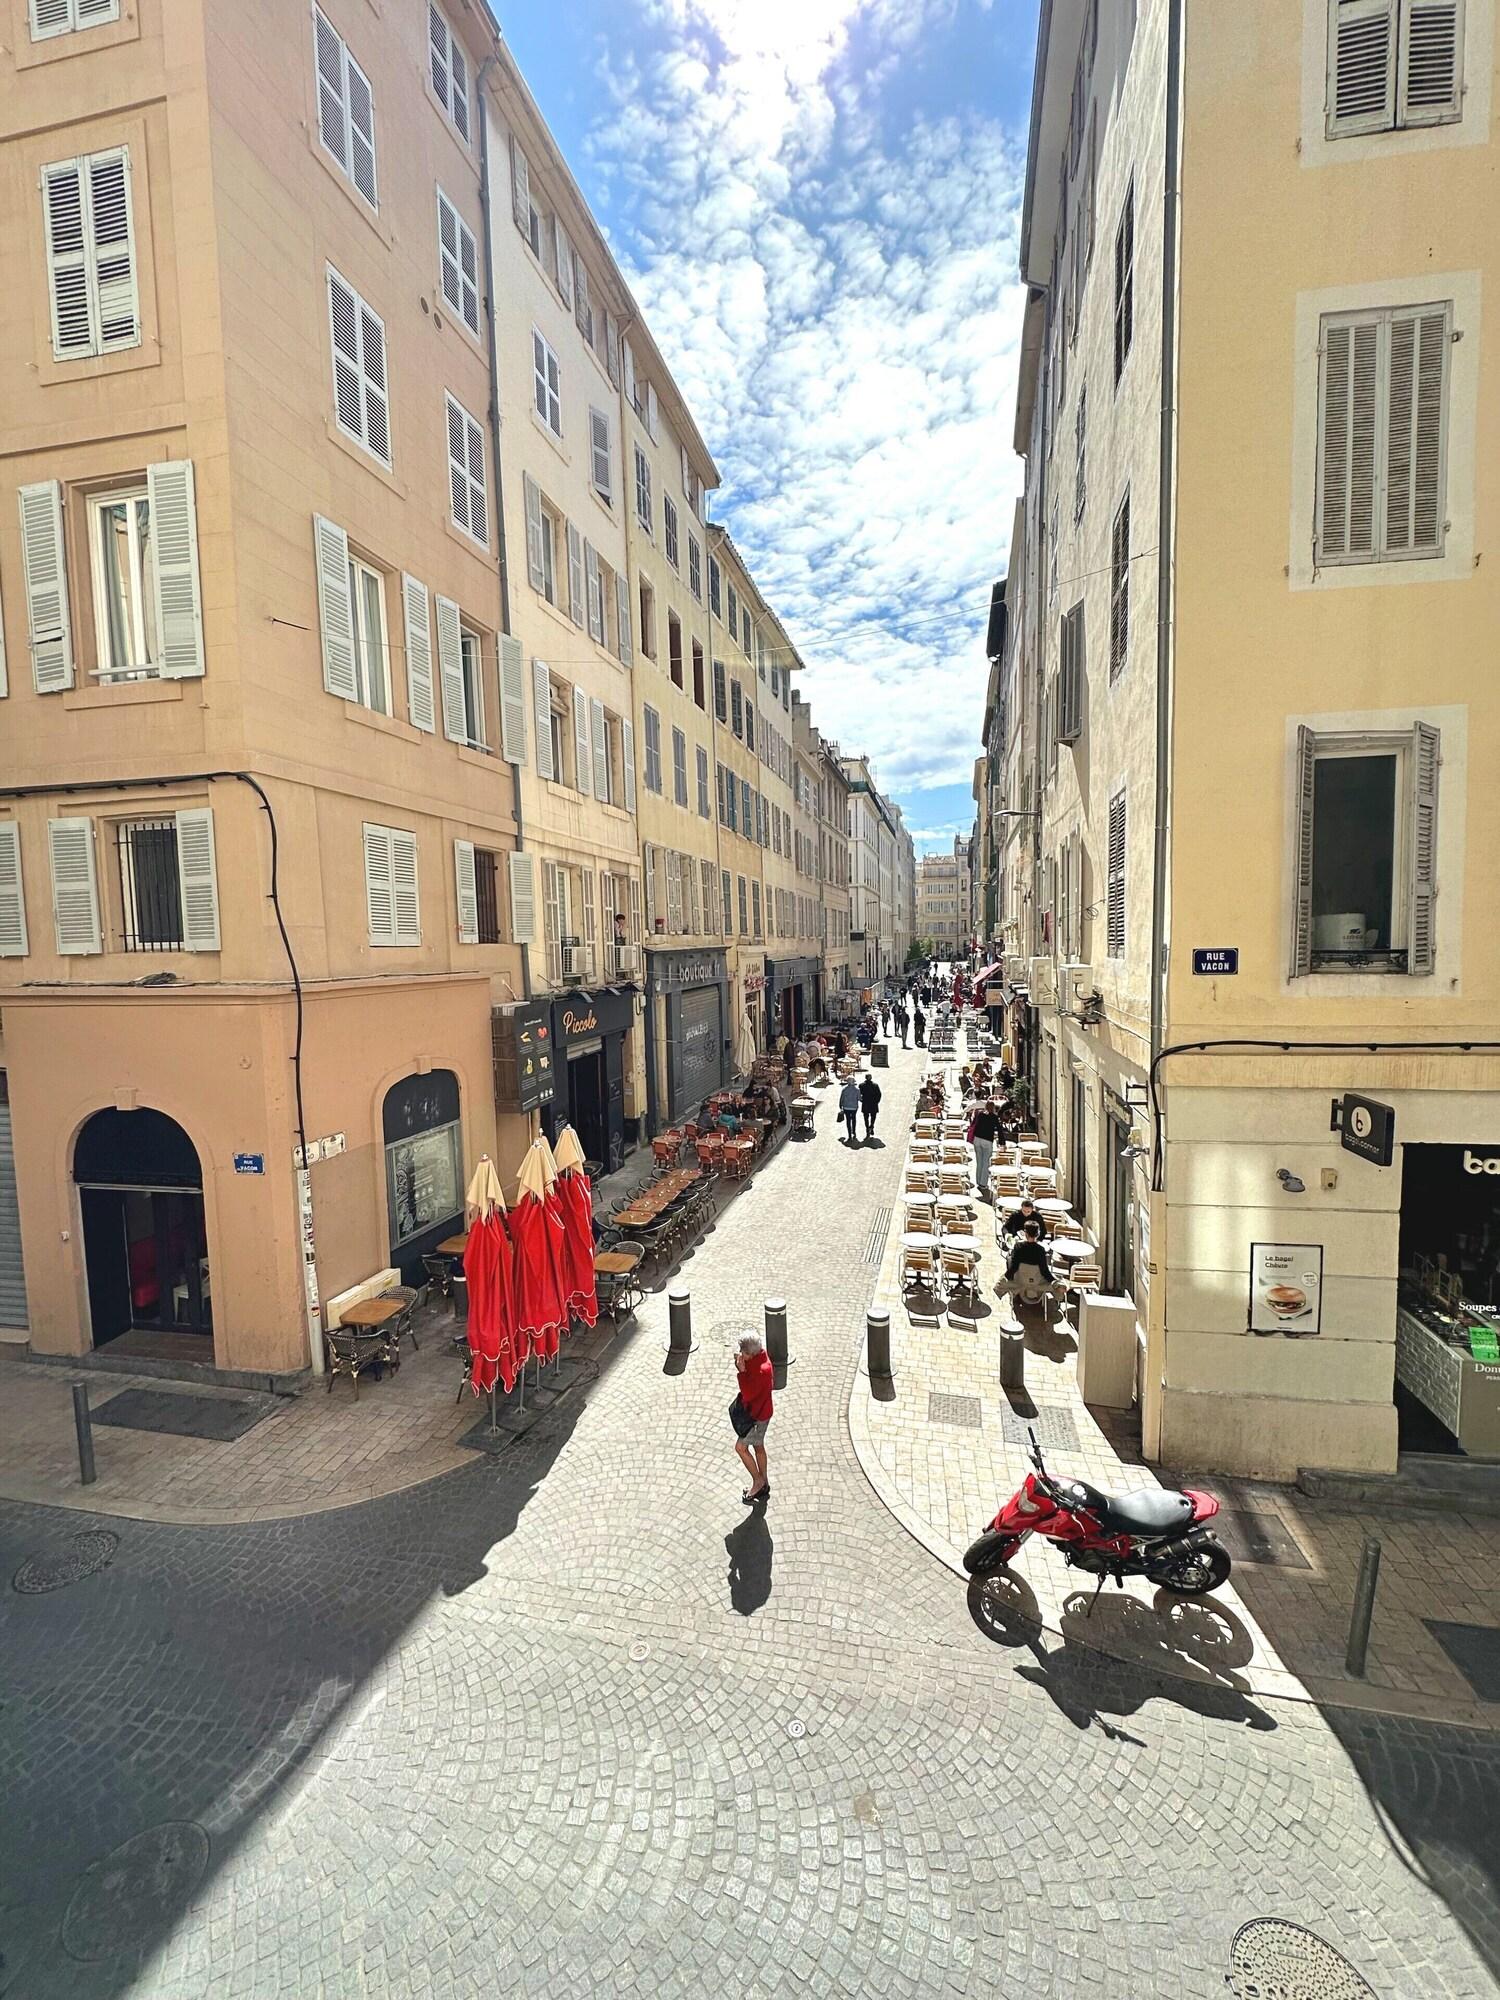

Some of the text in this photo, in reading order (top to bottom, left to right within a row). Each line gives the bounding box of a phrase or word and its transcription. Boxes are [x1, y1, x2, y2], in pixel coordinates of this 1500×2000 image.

[1206, 952, 1225, 961] RUE
[679, 961, 713, 983] boutique
[1201, 962, 1230, 971] VACON
[563, 1009, 597, 1035] Piccolo
[1458, 1301, 1497, 1313] Soupes
